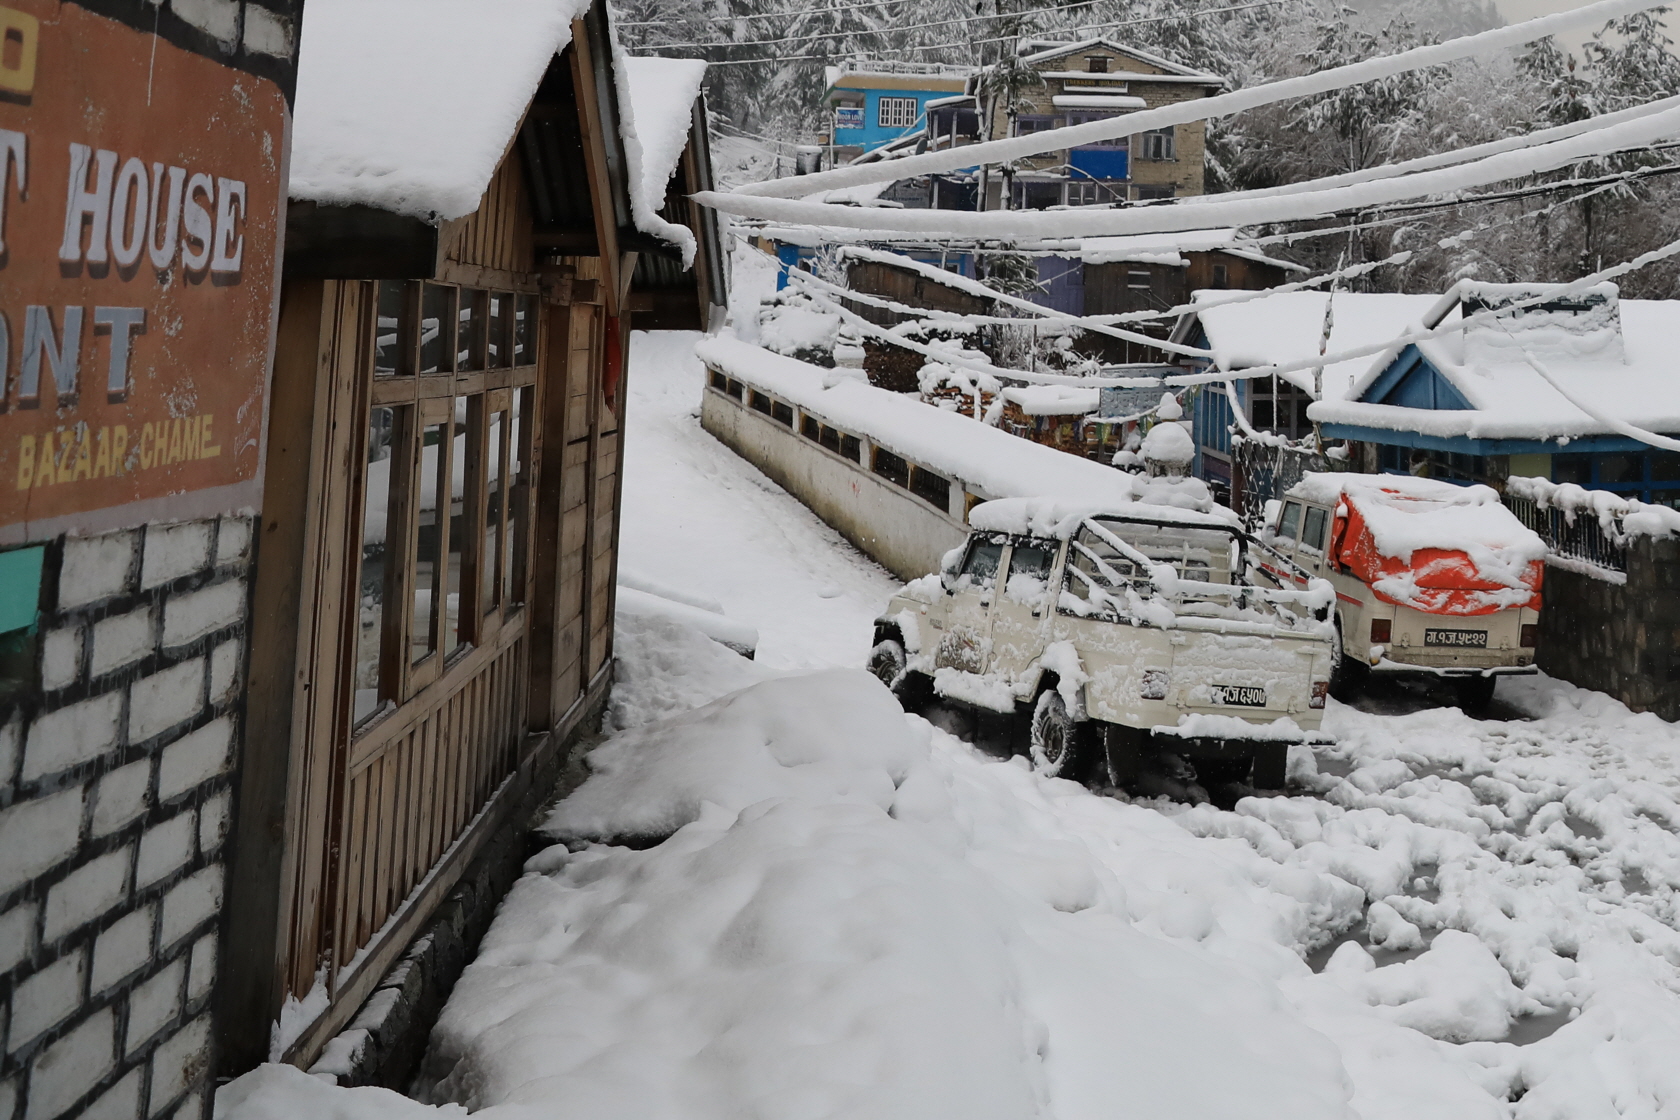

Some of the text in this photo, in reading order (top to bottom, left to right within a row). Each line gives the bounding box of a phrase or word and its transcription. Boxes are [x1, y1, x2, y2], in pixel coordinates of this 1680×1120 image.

[59, 142, 248, 273] HOUSE
[0, 304, 145, 400] NT
[17, 425, 129, 491] BAZAAR
[139, 414, 221, 471] CHAME
